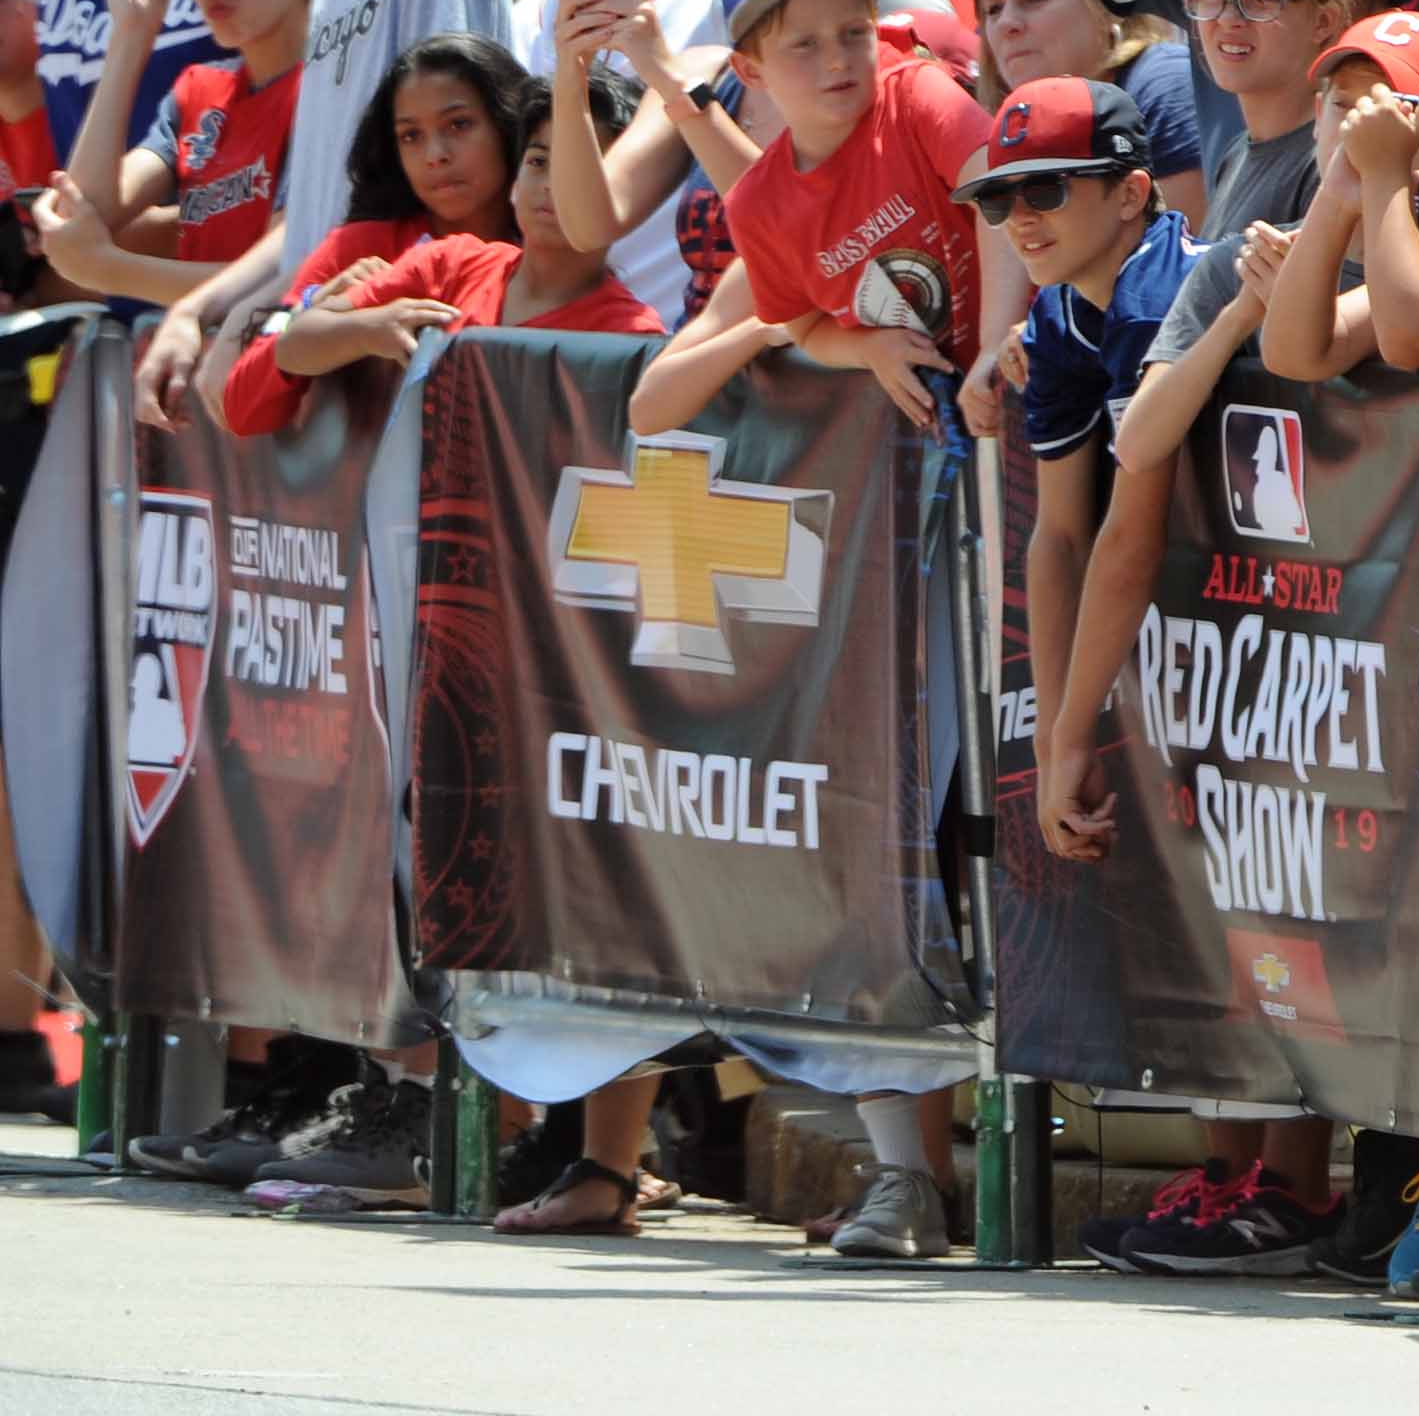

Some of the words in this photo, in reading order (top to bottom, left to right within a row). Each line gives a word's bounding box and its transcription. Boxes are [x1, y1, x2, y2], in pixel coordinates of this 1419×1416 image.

[1000, 102, 1031, 147] C
[261, 521, 347, 590] NATIONAL
[1203, 553, 1263, 605] ALL
[1272, 560, 1344, 615] STAR
[225, 589, 348, 694] PASTIME
[1137, 602, 1222, 768] RED
[1221, 614, 1386, 783] CARPET
[547, 731, 830, 849] CHEVROLET
[1196, 763, 1327, 922] SHOW
[1333, 807, 1378, 853] 19
